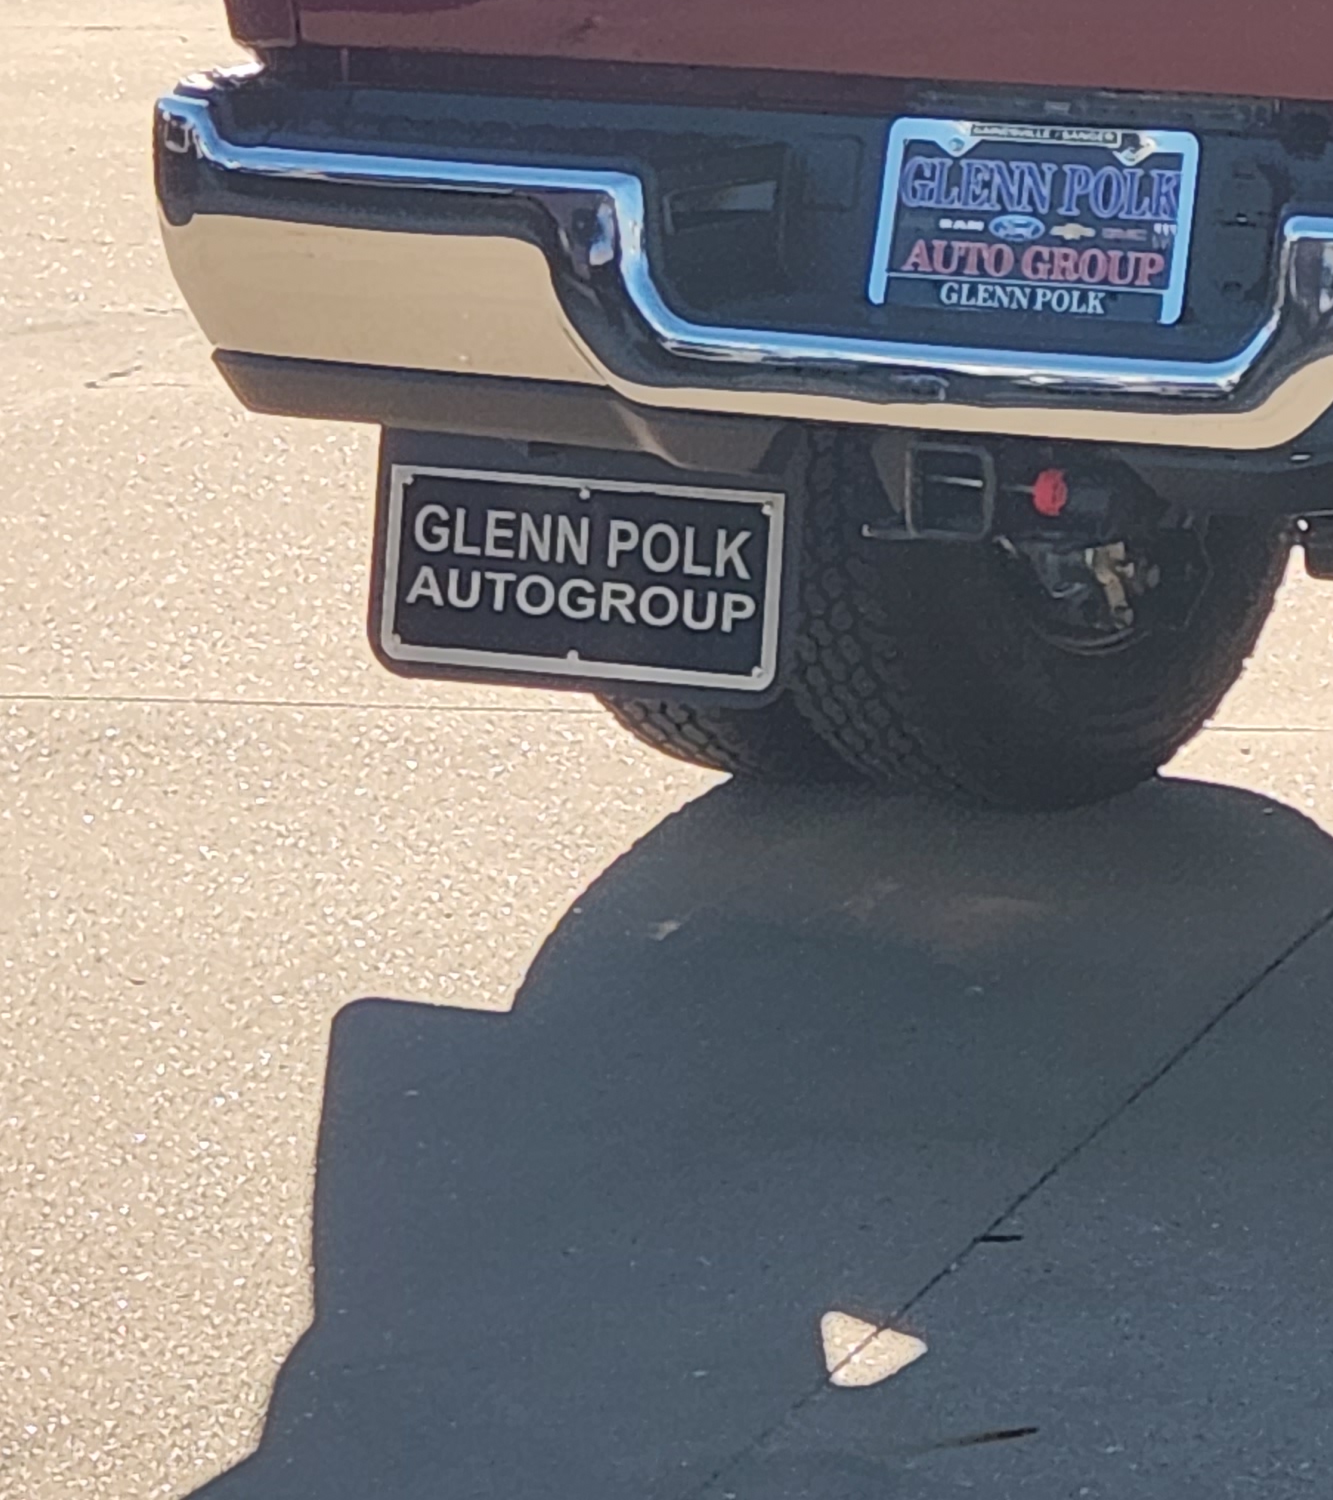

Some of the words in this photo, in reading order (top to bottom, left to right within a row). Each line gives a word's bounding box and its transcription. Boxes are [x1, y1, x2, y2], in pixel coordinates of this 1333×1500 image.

[901, 155, 1061, 215] GLENN
[1057, 163, 1181, 221] POLK
[901, 239, 1015, 278] AUTO
[1021, 245, 1165, 287] GROUP
[939, 281, 1031, 310] GLENN
[1032, 289, 1106, 315] POLK
[413, 503, 591, 566] GLENN
[606, 518, 753, 580] POLK
[405, 565, 757, 634] AUTOGROUP
